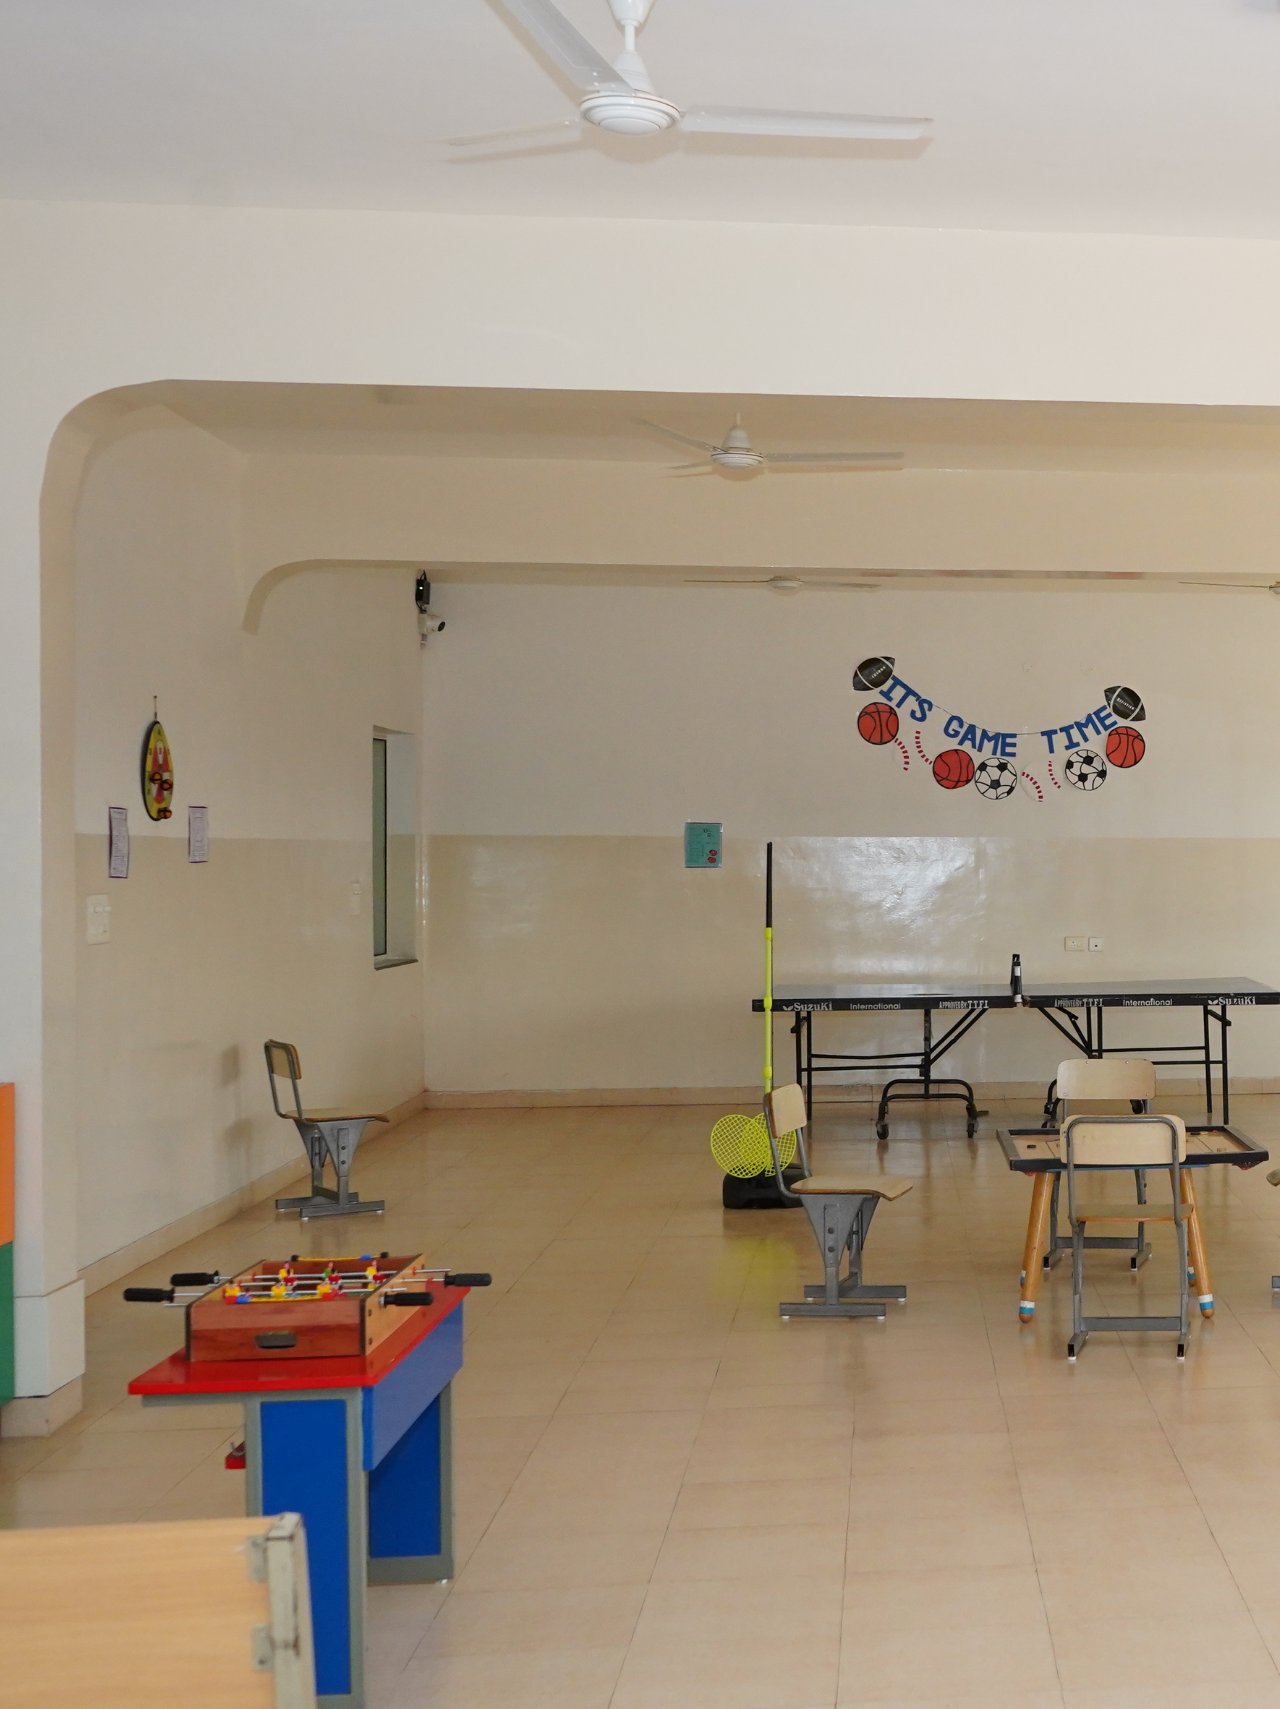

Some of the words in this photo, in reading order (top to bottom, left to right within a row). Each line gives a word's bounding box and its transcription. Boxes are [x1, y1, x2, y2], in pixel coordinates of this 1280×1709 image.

[943, 715, 1017, 757] GAME
[1040, 704, 1118, 754] TIME
[850, 1003, 901, 1011] International
[1122, 998, 1173, 1007] International
